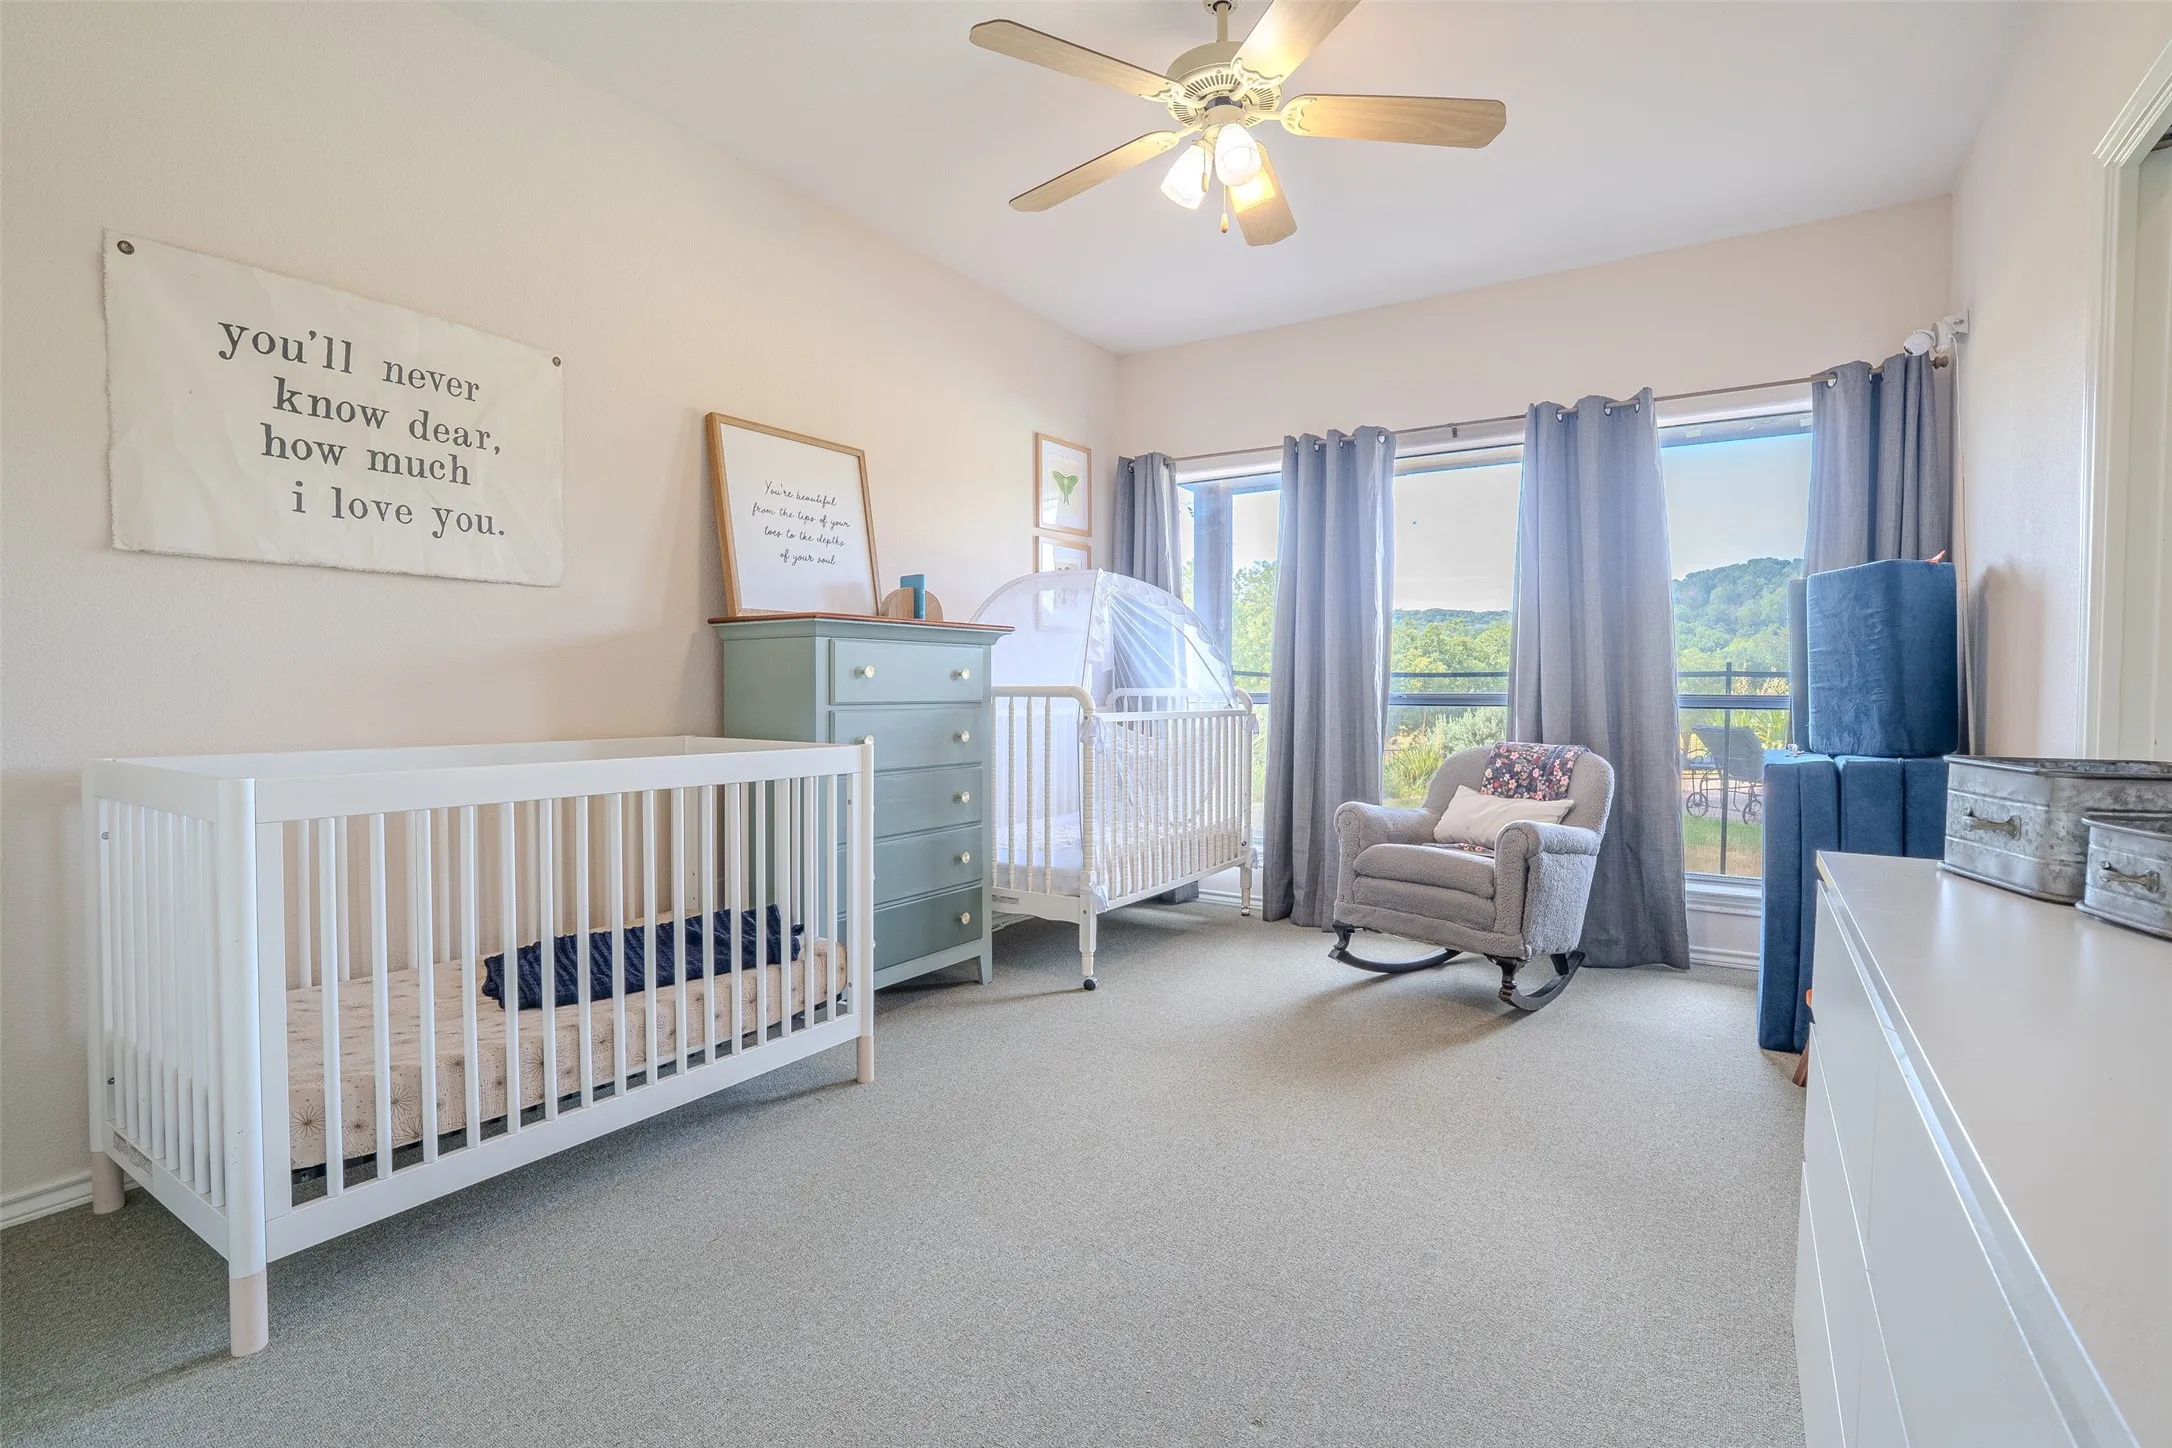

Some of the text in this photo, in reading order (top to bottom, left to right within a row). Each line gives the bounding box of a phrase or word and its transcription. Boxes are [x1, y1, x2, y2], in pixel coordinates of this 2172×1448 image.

[218, 321, 480, 402] you'll never
[272, 375, 501, 456] know dear,
[259, 422, 471, 486] how much
[291, 480, 505, 539] i love you.
[764, 479, 837, 509] You're beautiful
[751, 502, 851, 531] from the tips of your
[764, 525, 846, 548] toes to the depths
[779, 548, 836, 567] of your soul
